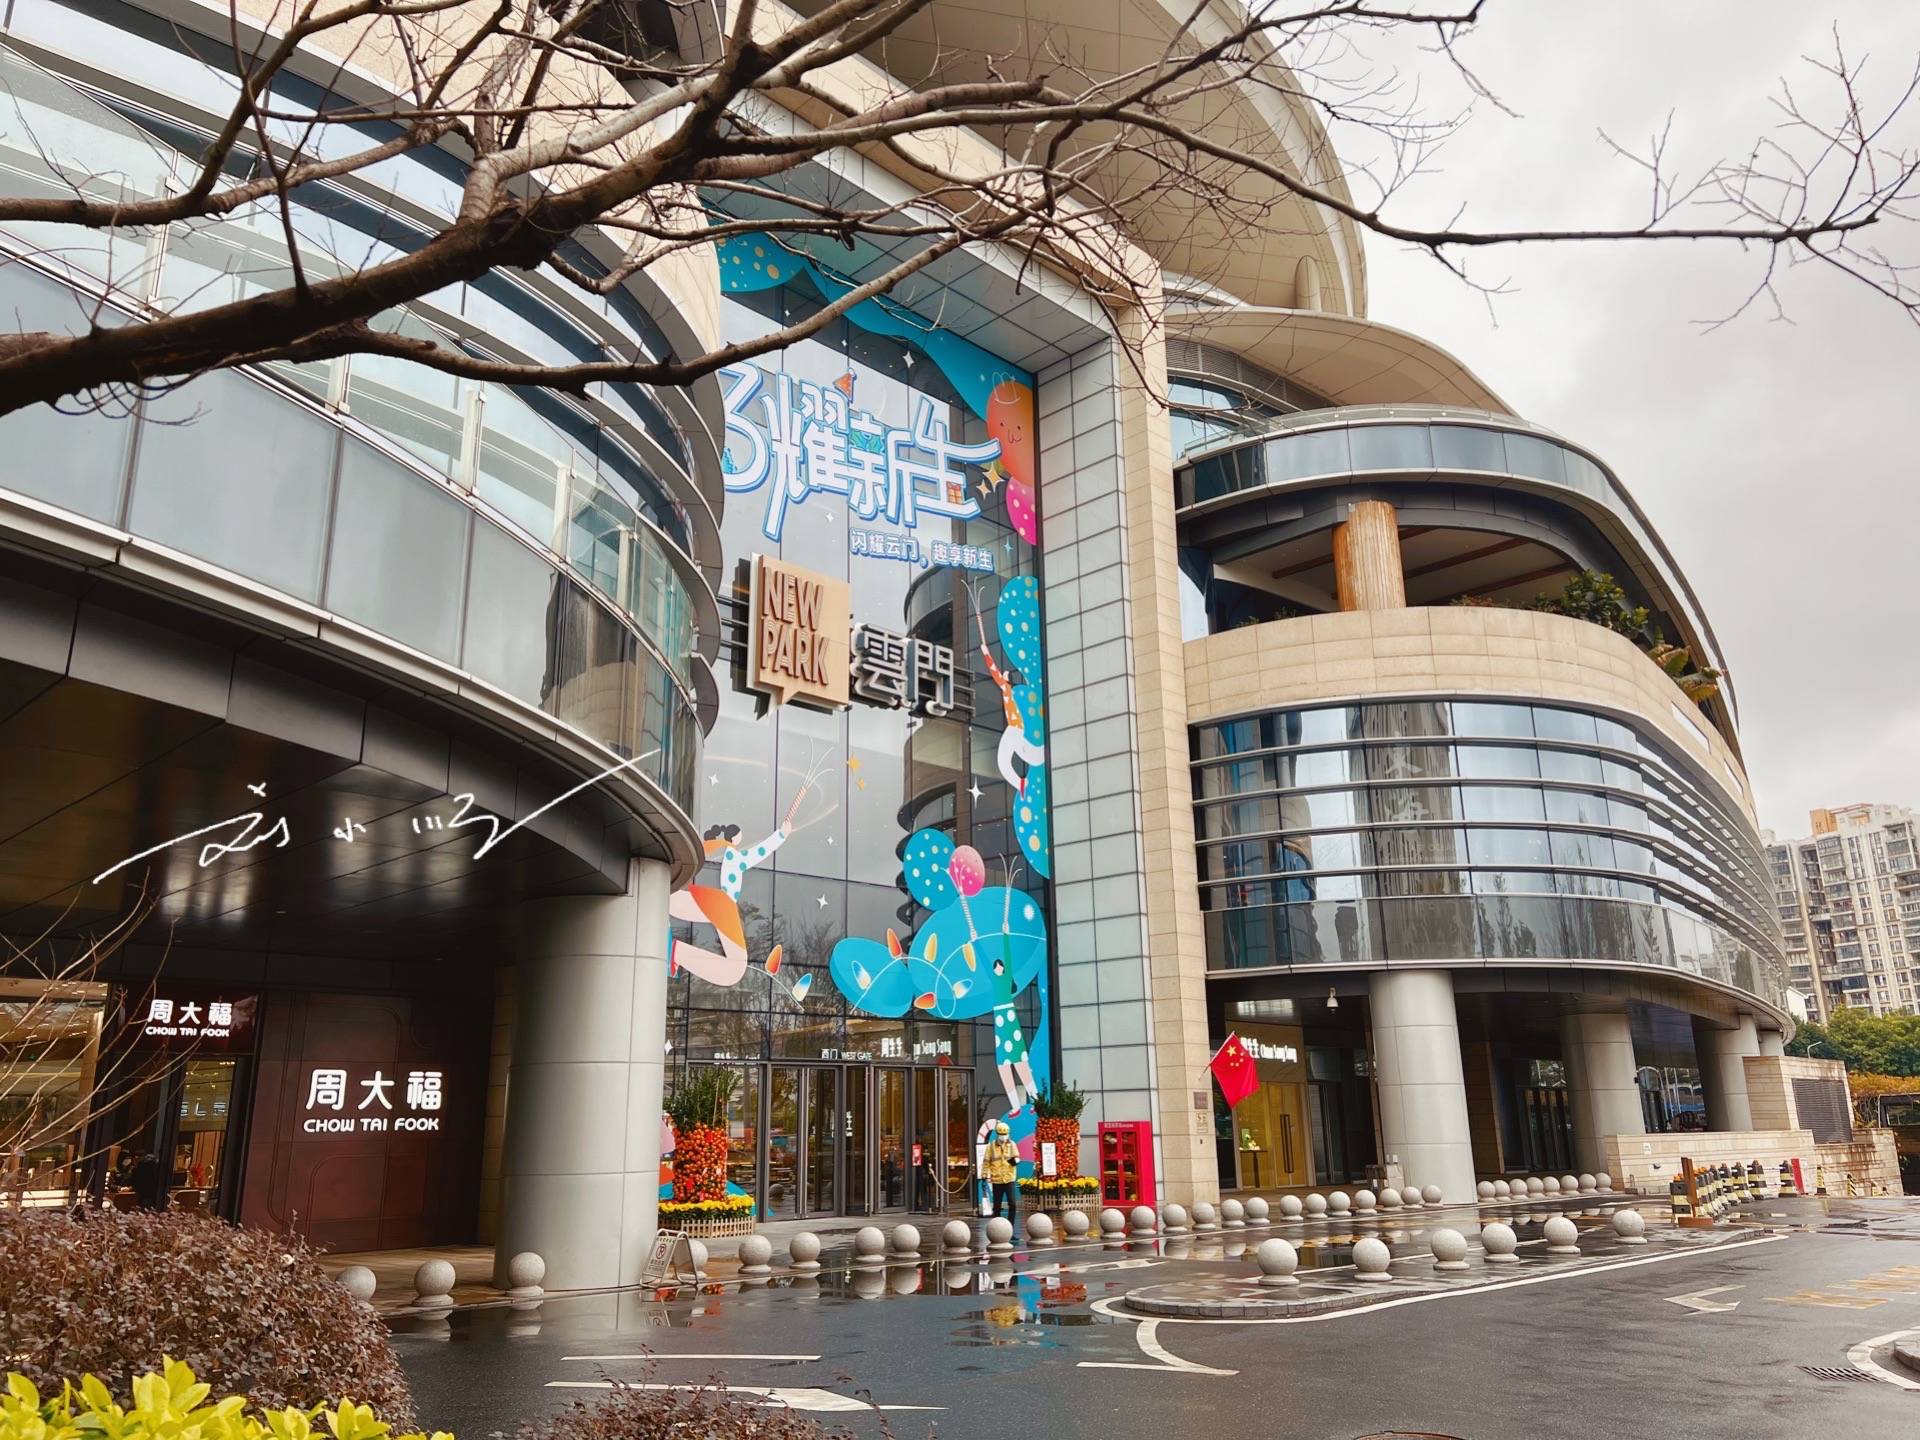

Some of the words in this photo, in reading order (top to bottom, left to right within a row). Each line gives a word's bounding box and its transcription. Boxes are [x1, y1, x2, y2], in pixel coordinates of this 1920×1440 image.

[762, 566, 824, 631] NEW
[760, 616, 831, 686] PARK
[856, 623, 954, 712] 雲門
[145, 1026, 177, 1036] CHOW
[179, 1027, 198, 1037] TAI
[200, 1028, 230, 1037] FOOK
[147, 999, 232, 1026] 周大福
[305, 1069, 443, 1111] 周大福
[303, 1119, 355, 1132] CHOW
[360, 1118, 388, 1131] TAI
[394, 1117, 439, 1131] FOOK
